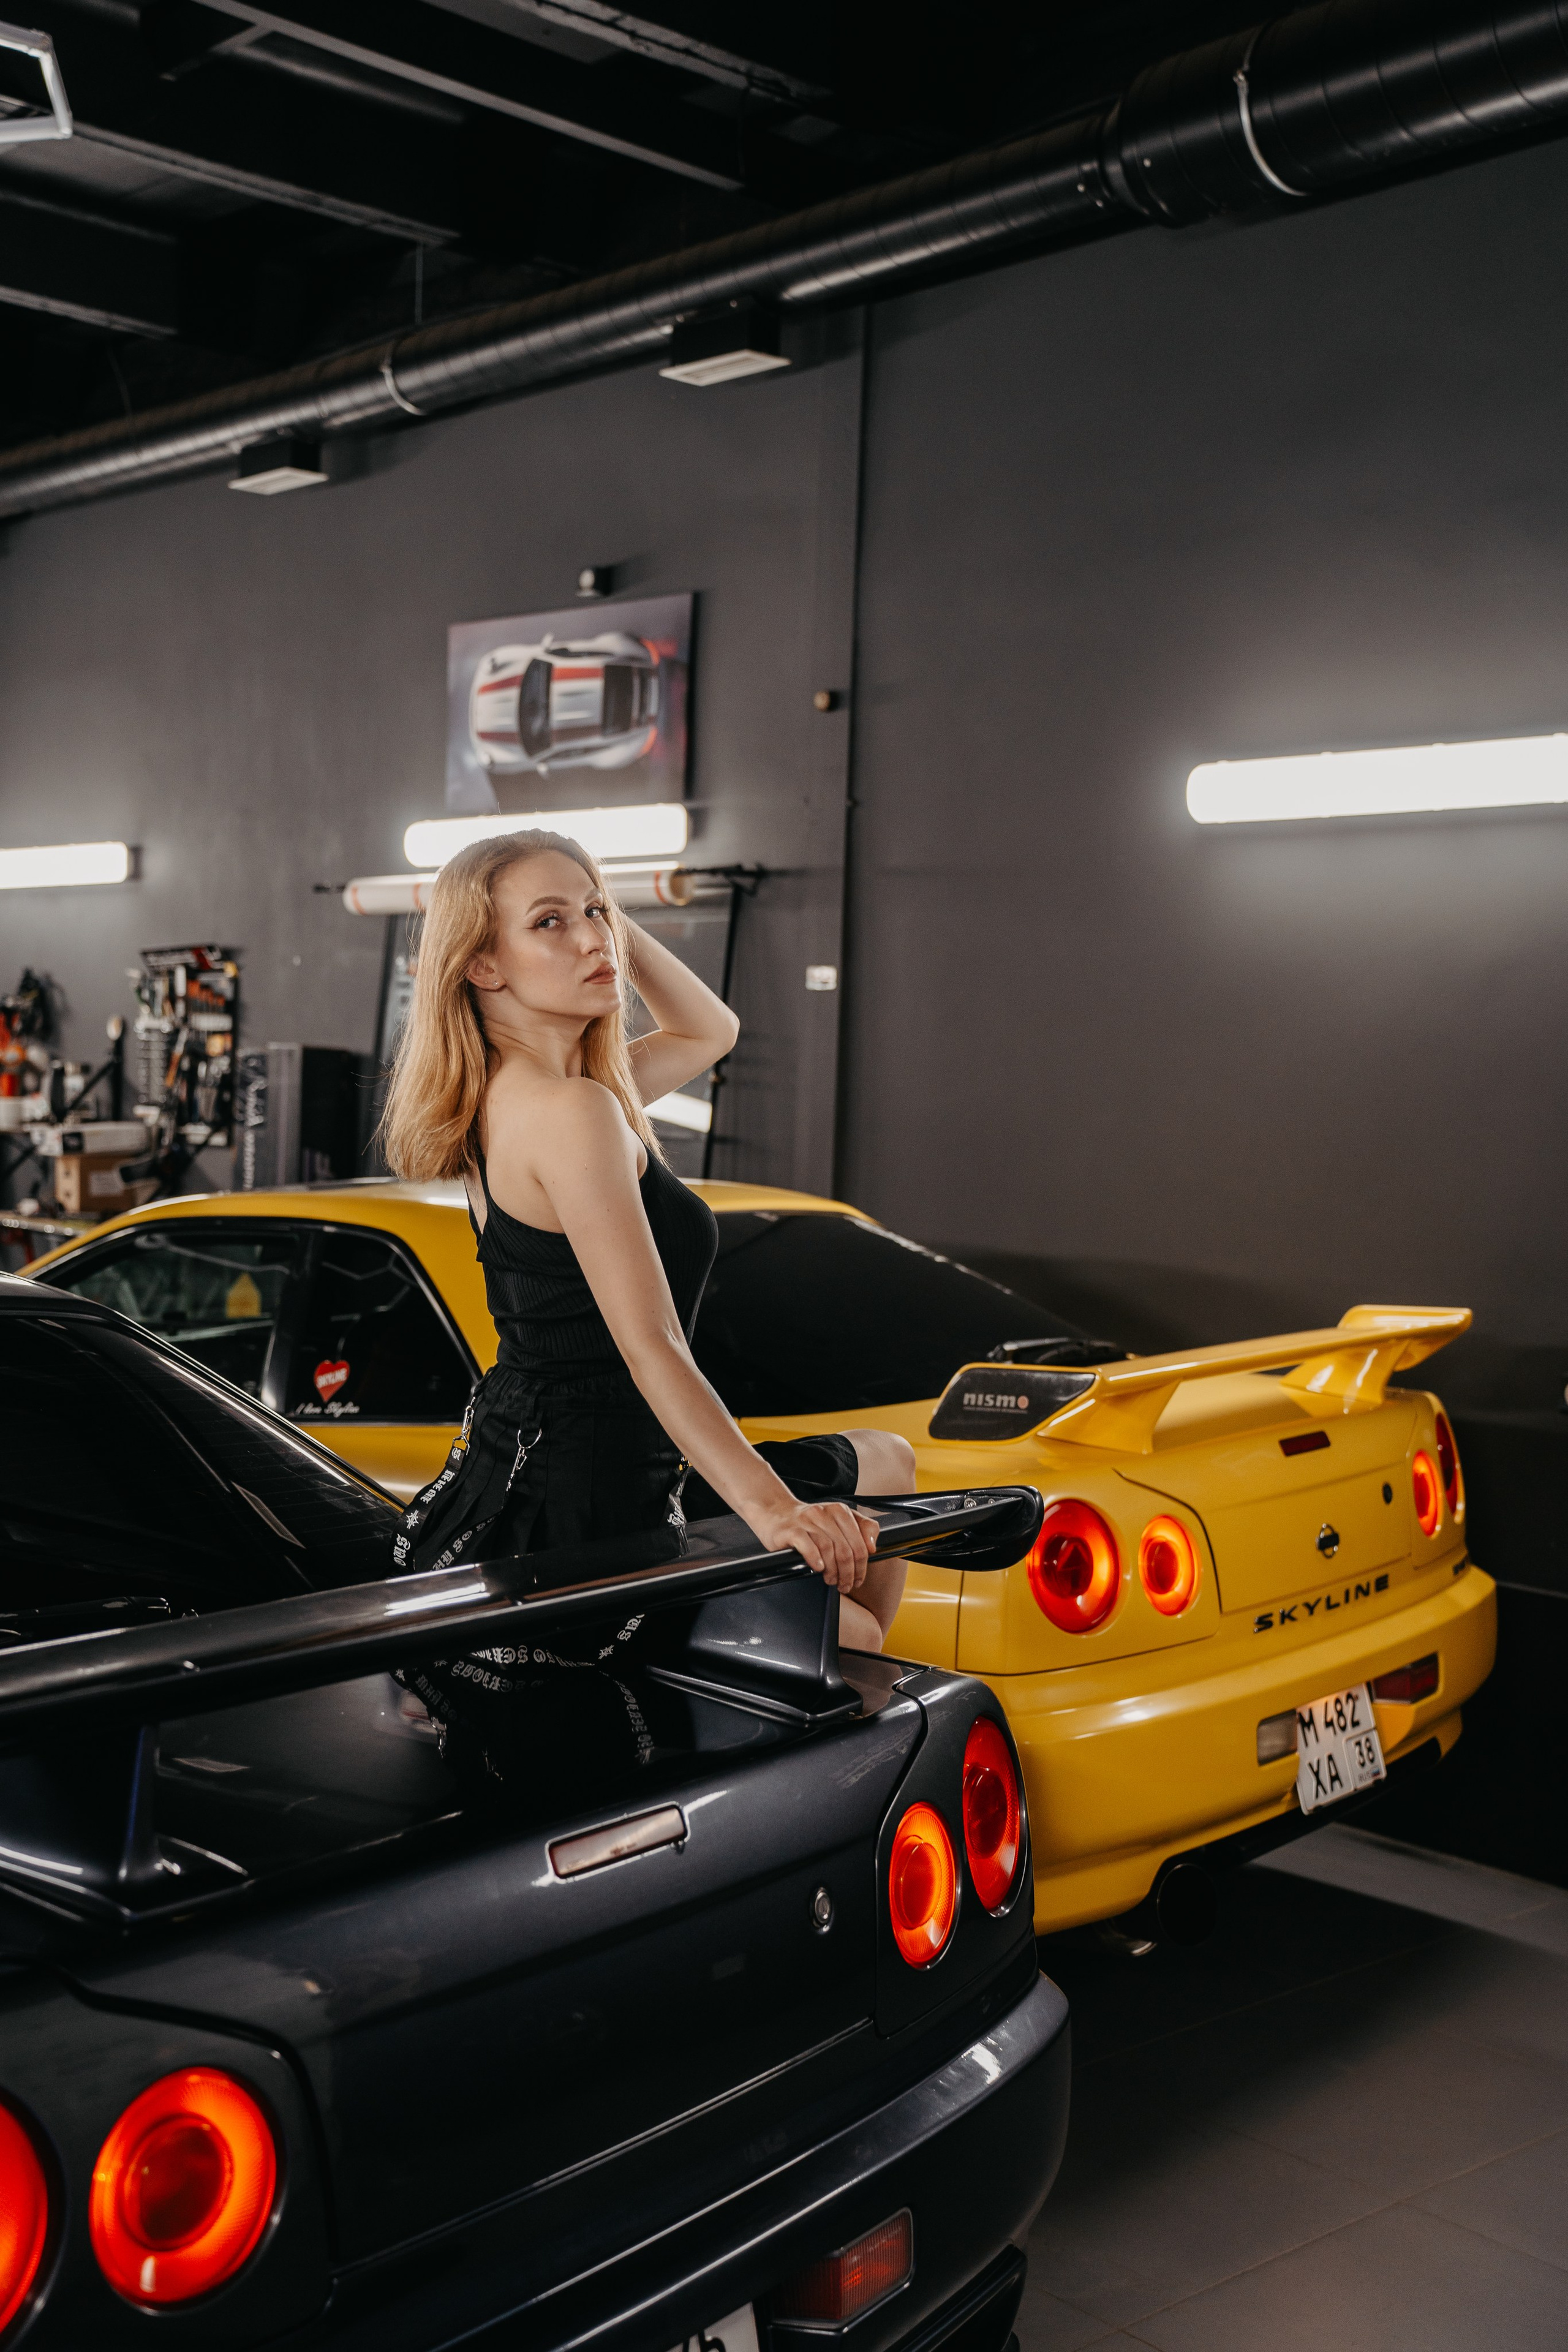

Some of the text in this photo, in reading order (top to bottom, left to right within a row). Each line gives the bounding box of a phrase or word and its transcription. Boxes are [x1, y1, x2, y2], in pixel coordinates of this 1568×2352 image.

[963, 1393, 1030, 1409] nismo
[1253, 1574, 1389, 1634] SKYLINE
[1324, 1692, 1360, 1736] 482
[1354, 1738, 1374, 1768] 38
